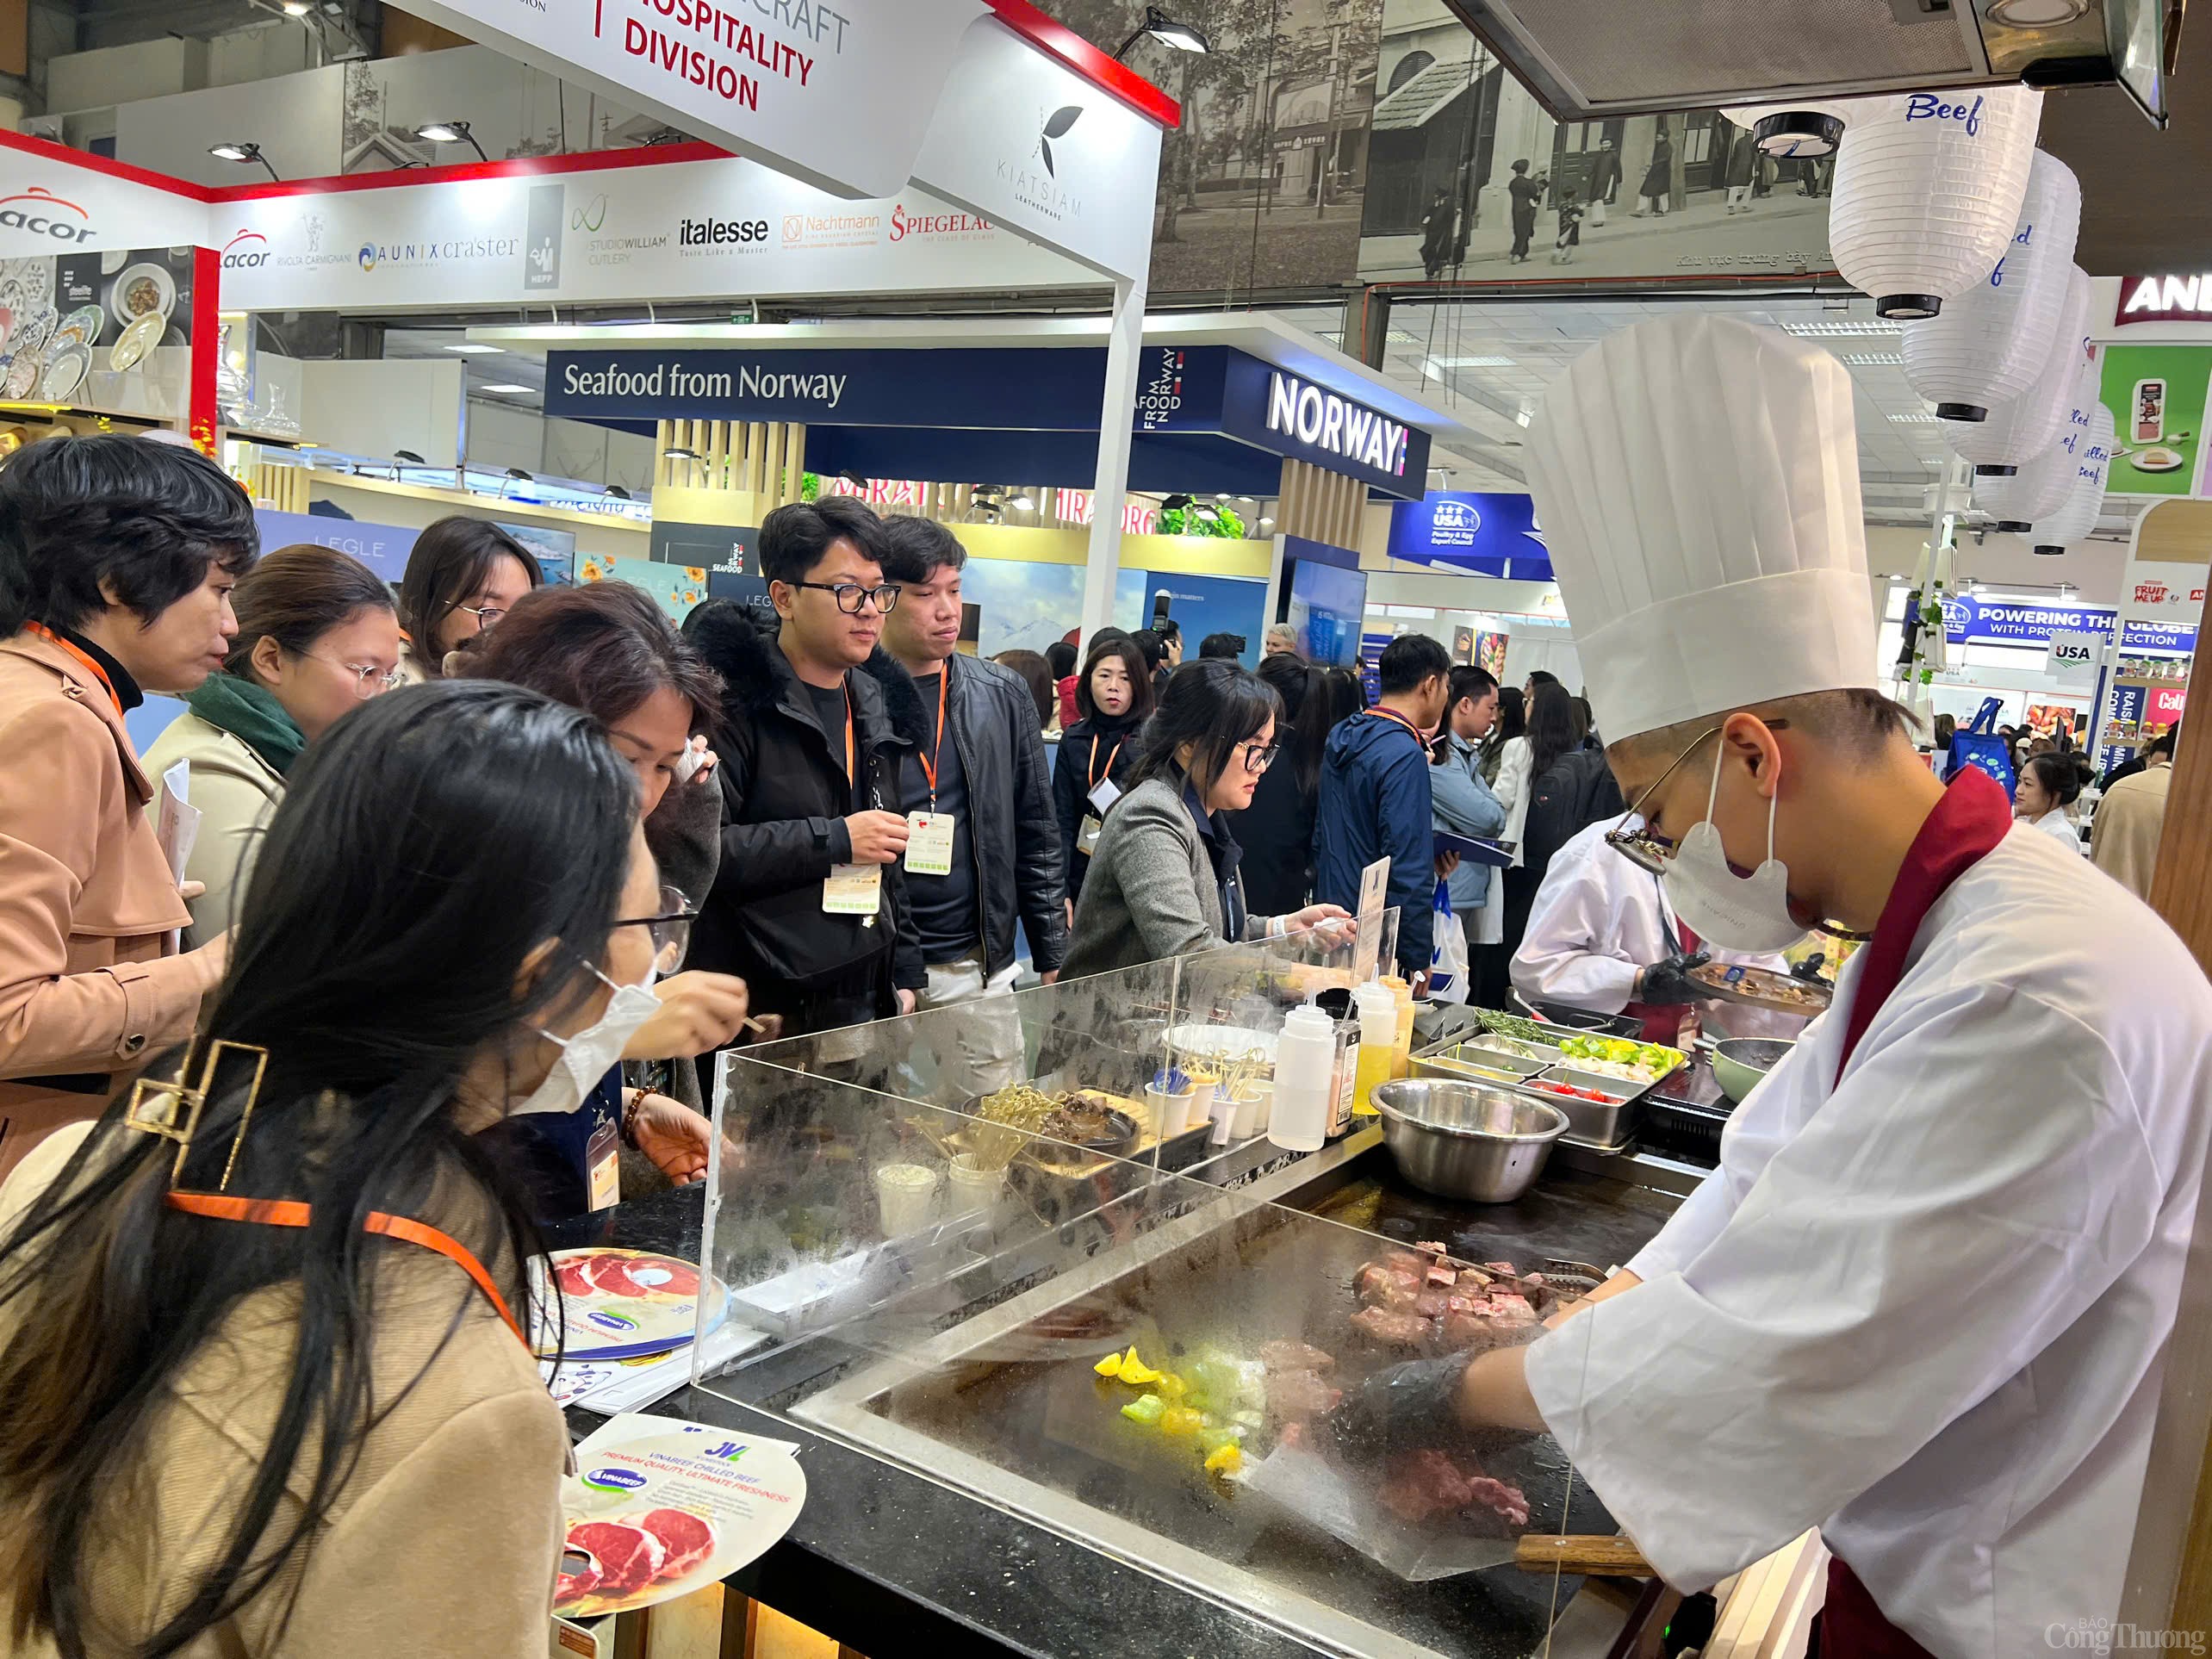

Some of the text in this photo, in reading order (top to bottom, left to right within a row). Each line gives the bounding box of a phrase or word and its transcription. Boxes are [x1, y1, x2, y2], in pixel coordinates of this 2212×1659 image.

[643, 0, 814, 86] SPITALITY
[624, 17, 758, 111] DIVISION
[1904, 94, 1984, 137] Beef
[997, 158, 1081, 217] KIATSIAM
[1015, 193, 1061, 221] LEATHERWARE
[680, 218, 769, 245] italesse
[805, 214, 879, 232] Nachtmann
[377, 245, 438, 261] AUNIX
[705, 248, 724, 257] Like
[737, 246, 768, 255] Master
[220, 252, 270, 269] acor
[531, 275, 552, 283] HEPP
[563, 363, 848, 408] Seafood from Norway
[1134, 395, 1181, 410] FOOD
[1266, 372, 1403, 473] NORWAY
[1432, 513, 1464, 527] USA
[314, 536, 386, 557] LEGLE
[712, 563, 743, 574] SEAFOOD
[2134, 585, 2169, 595] FRUIT
[746, 594, 774, 608] LEG
[2134, 594, 2165, 604] ME UP
[1942, 610, 1957, 620] SA
[1978, 607, 2082, 627] POWERING
[1990, 623, 2024, 635] WITH
[2055, 644, 2091, 660] USA
[649, 1452, 693, 1468] VINABEEF
[693, 1463, 735, 1478] CHILLED
[734, 1473, 761, 1484] BEEF
[601, 1451, 646, 1465] PREMIUM
[686, 1469, 733, 1488] ULTIMATE
[731, 1482, 792, 1504] FRESHNESS
[601, 1472, 643, 1488] VINABEEF
